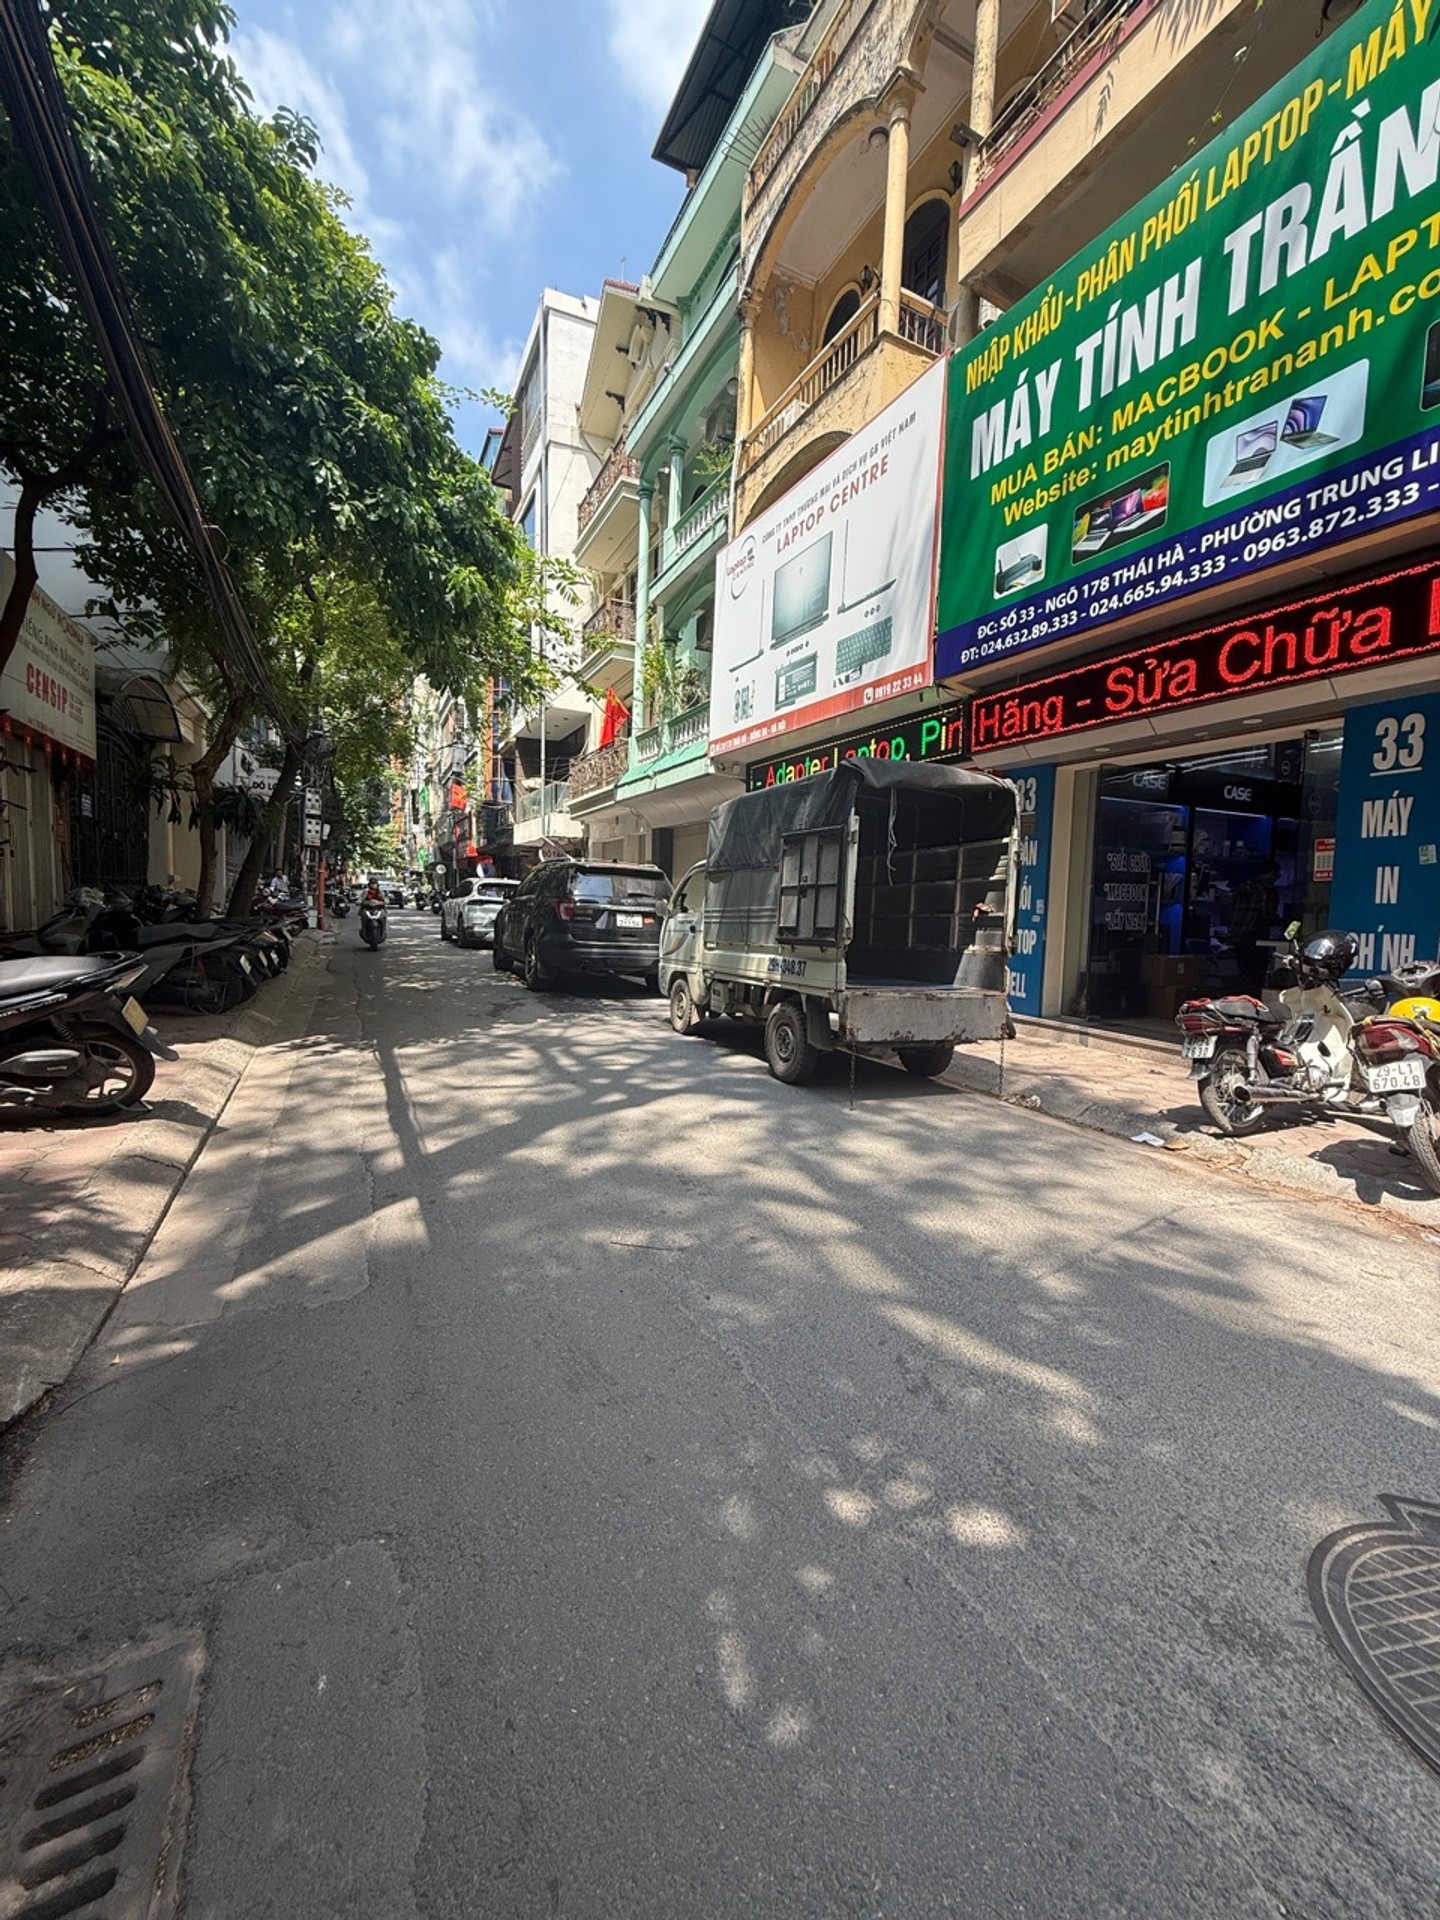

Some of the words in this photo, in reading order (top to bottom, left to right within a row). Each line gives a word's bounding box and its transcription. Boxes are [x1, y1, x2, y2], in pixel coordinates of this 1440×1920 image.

[966, 335, 1010, 395] NHẬP
[1013, 284, 1063, 359] KHẨU
[1076, 232, 1136, 312] PHÂN
[1140, 169, 1200, 262] PHỐI
[1205, 78, 1324, 211] LAPTOP
[970, 358, 1062, 481] MÁY
[1075, 256, 1202, 412] TÍNH
[1223, 78, 1440, 316] TRẦN
[991, 462, 1037, 506] MUA
[1043, 425, 1102, 475] BÁN:
[1111, 307, 1286, 435] MACBOOK
[776, 505, 824, 554] LAPTOP
[830, 453, 889, 513] CENTRE
[1003, 461, 1097, 526] Website:
[960, 647, 980, 664] ĐT:
[980, 610, 1078, 656] 024.632.89.333
[1089, 555, 1226, 617] 024.665.94.333
[1242, 482, 1420, 562] 0963.872.333
[976, 621, 998, 640] ĐC:
[1000, 608, 1017, 632] SỐ
[1019, 608, 1035, 624] 33
[1083, 577, 1109, 598] 178
[1112, 556, 1153, 586] THÁI
[1158, 543, 1185, 570] HÀ
[1201, 498, 1300, 553] PHƯỜNG
[1306, 456, 1403, 512] TRUNG
[27, 662, 68, 714] CENSIP
[978, 695, 1063, 742] Hãng
[1104, 656, 1197, 711] Sửa
[1219, 605, 1391, 684] Chữa
[765, 754, 828, 788] Adapter
[921, 717, 963, 755] Pin
[1373, 712, 1426, 771] 33
[1132, 772, 1168, 790] CASE
[1223, 785, 1252, 801] CASE
[1361, 790, 1414, 838] MÁY
[1375, 866, 1400, 904] IN
[1373, 1075, 1420, 1090] 670.48
[1377, 1063, 1412, 1077] 29-L1
